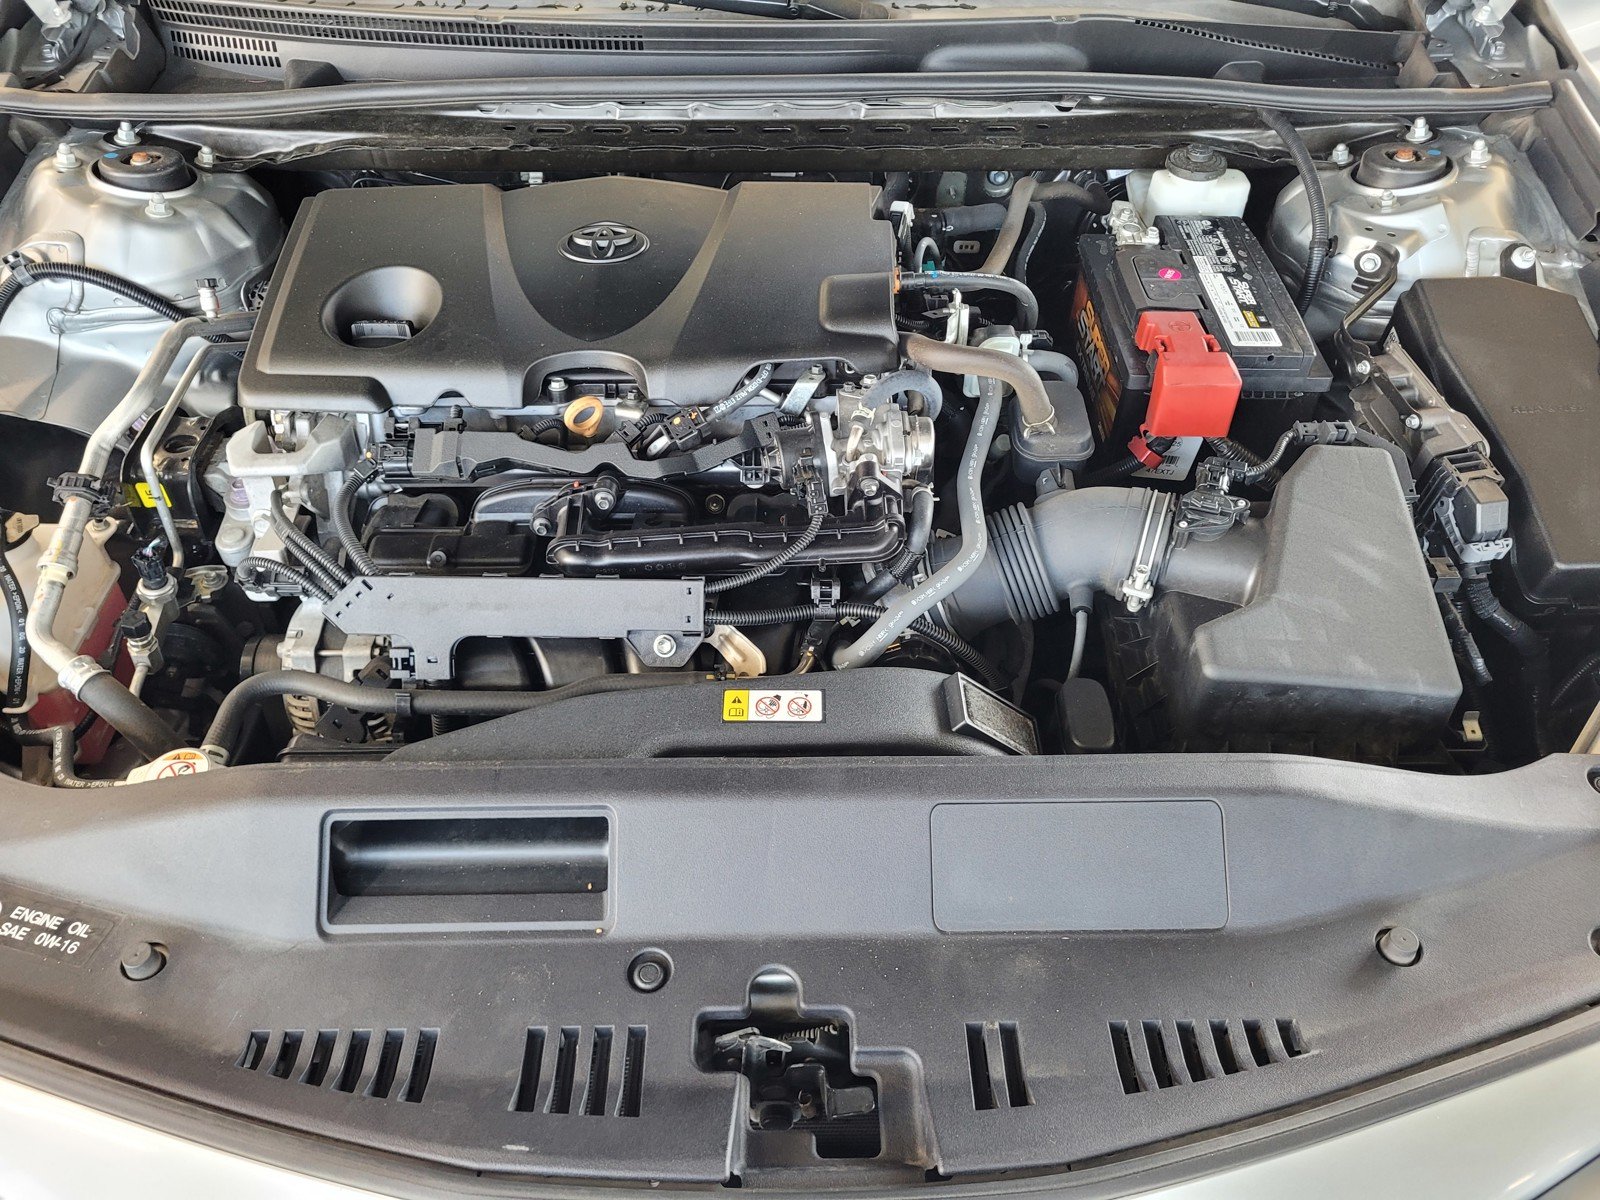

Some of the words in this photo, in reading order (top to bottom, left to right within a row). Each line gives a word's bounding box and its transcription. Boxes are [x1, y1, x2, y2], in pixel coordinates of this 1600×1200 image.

[1227, 276, 1249, 304] START
[1241, 281, 1257, 305] SUPER
[1078, 309, 1107, 387] START
[1086, 300, 1110, 372] SUPER
[0, 922, 31, 941] SAE
[34, 932, 80, 954] 0W-16
[9, 905, 65, 930] ENGINE
[67, 921, 90, 939] OIL
